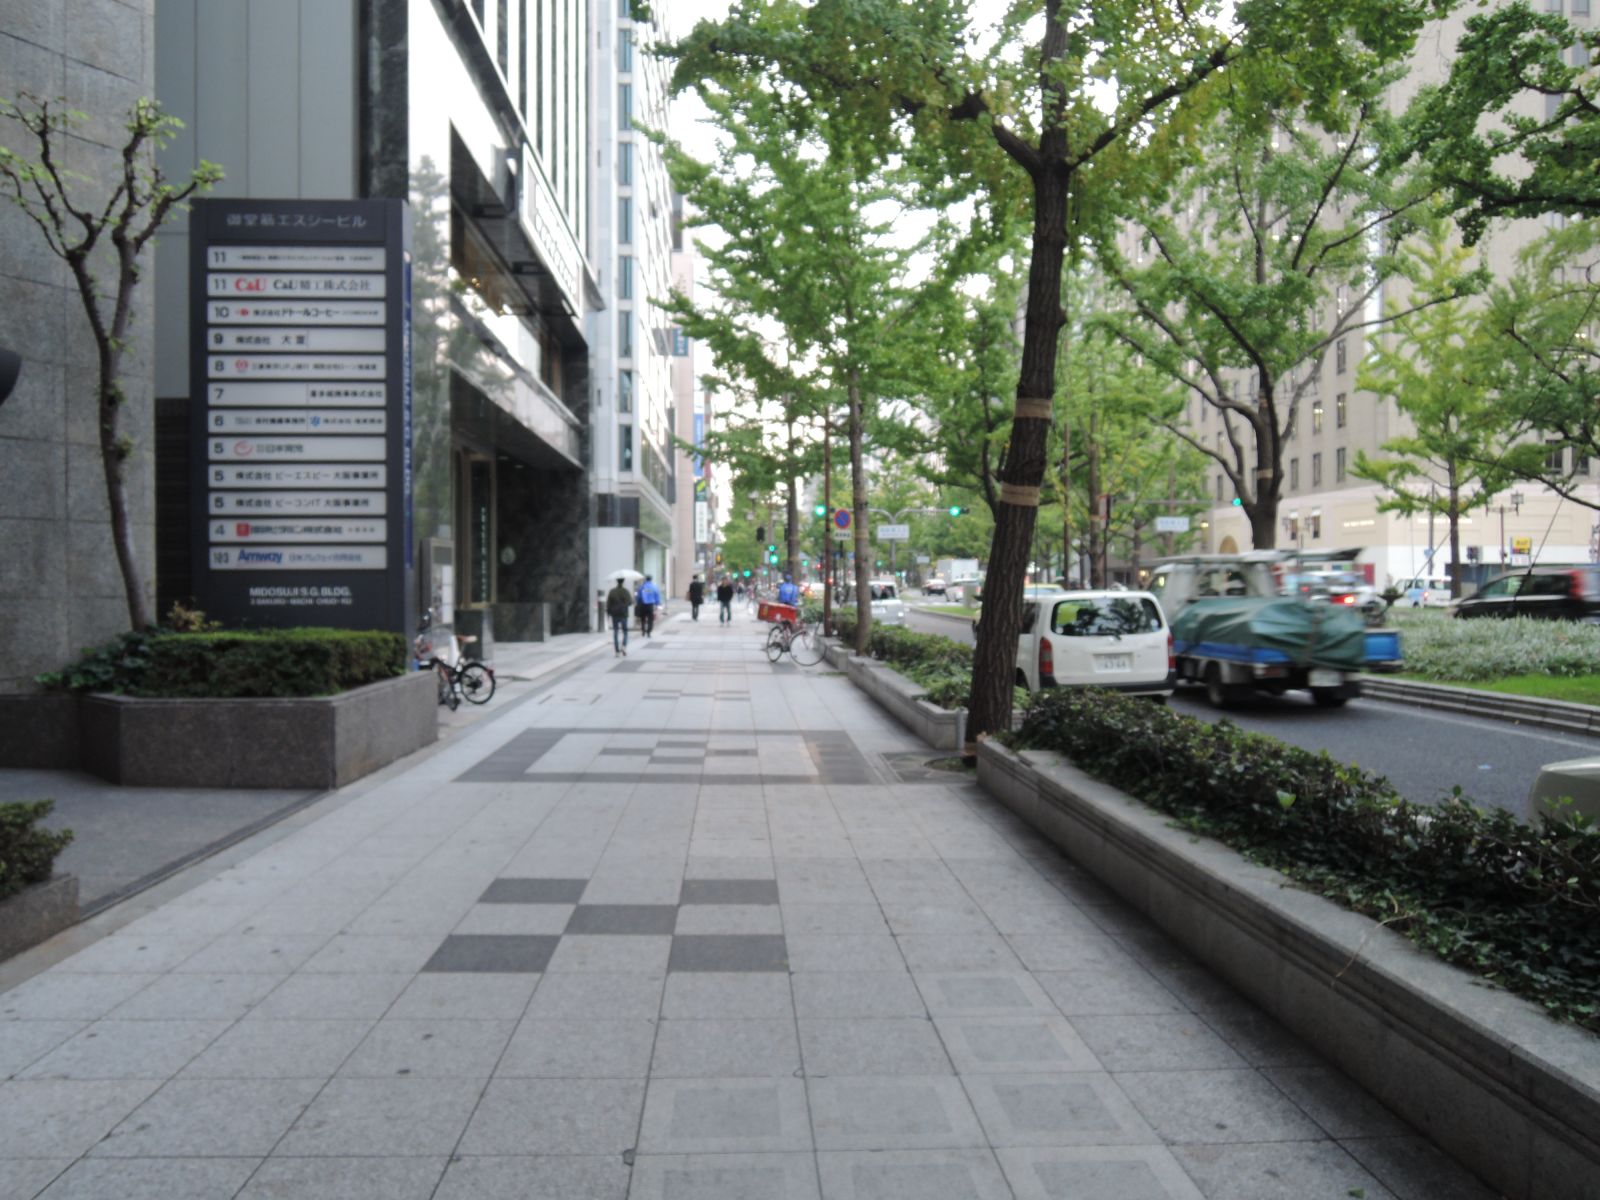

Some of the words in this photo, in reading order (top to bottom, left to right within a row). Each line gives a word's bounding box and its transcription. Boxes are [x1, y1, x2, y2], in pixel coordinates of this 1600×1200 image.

[214, 251, 227, 263] 11
[214, 278, 227, 290] 11
[214, 306, 230, 318] 10
[213, 333, 224, 344] 9
[214, 360, 225, 371] 8
[214, 387, 224, 399] 7
[214, 442, 224, 454] 5
[214, 470, 224, 482] 5
[214, 497, 224, 508] 5
[215, 524, 225, 535] 4
[238, 549, 283, 563] Amway
[249, 587, 299, 597] MIDOSUJI
